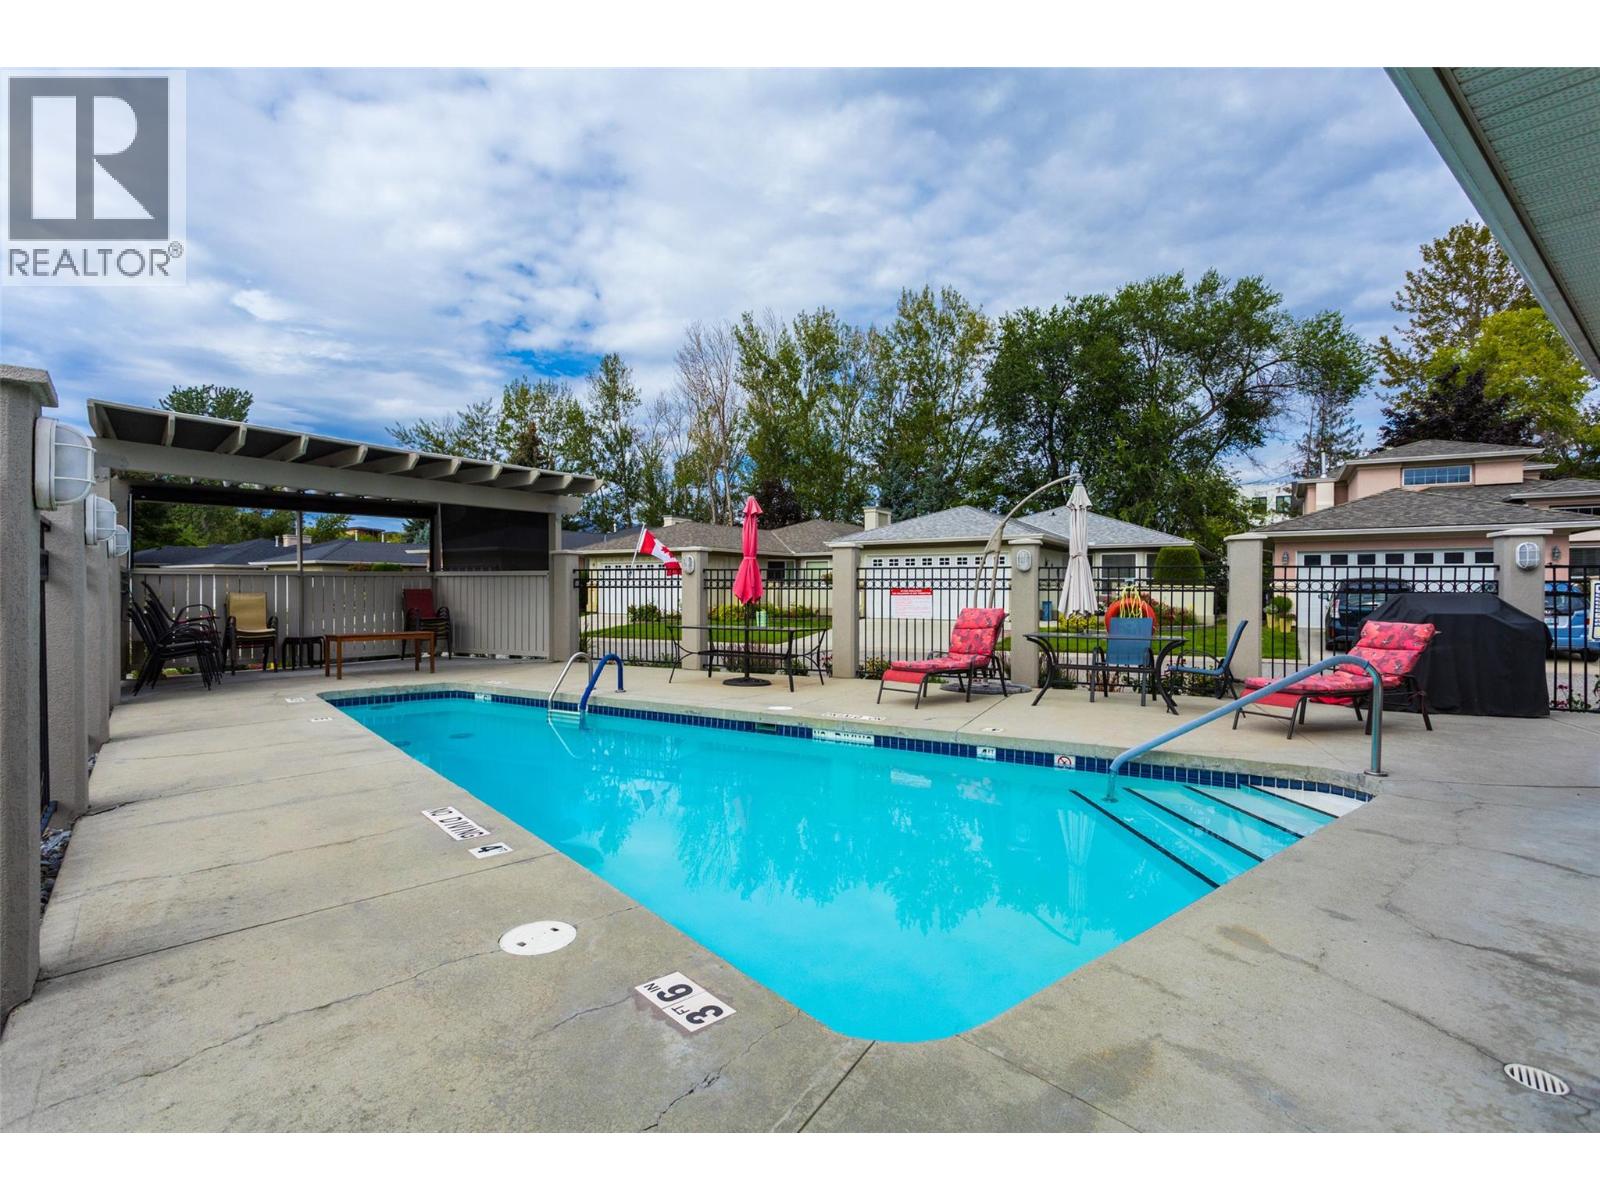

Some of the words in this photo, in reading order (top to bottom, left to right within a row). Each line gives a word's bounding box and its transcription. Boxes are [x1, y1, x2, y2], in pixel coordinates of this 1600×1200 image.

[439, 816, 485, 839] DIVING
[478, 846, 503, 854] 4
[643, 983, 661, 993] IN
[656, 984, 694, 1002] 6
[671, 1005, 690, 1016] FT
[686, 1005, 724, 1025] 3
